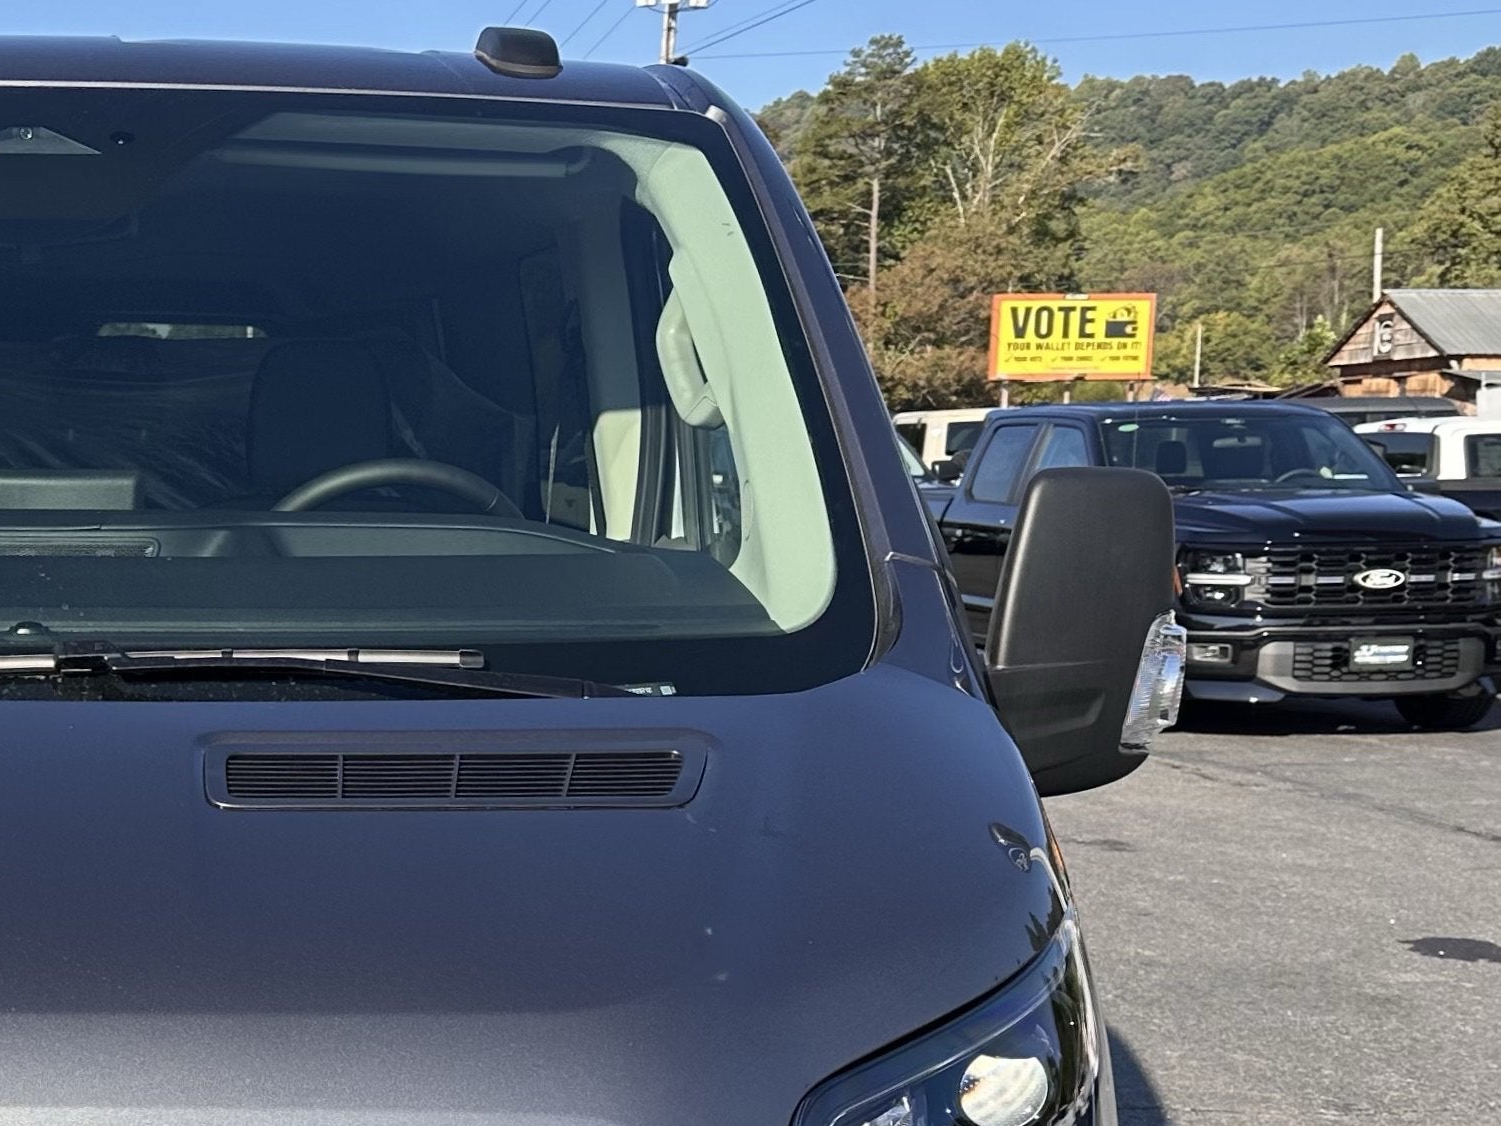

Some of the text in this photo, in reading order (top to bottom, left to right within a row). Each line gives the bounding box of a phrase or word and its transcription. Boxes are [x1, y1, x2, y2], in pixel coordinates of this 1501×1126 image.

[1010, 305, 1098, 339] VOTE
[1007, 341, 1031, 351] YOUR
[1035, 341, 1071, 351] WALLET
[1074, 341, 1113, 351] DEPENDS
[1116, 341, 1128, 350] ON
